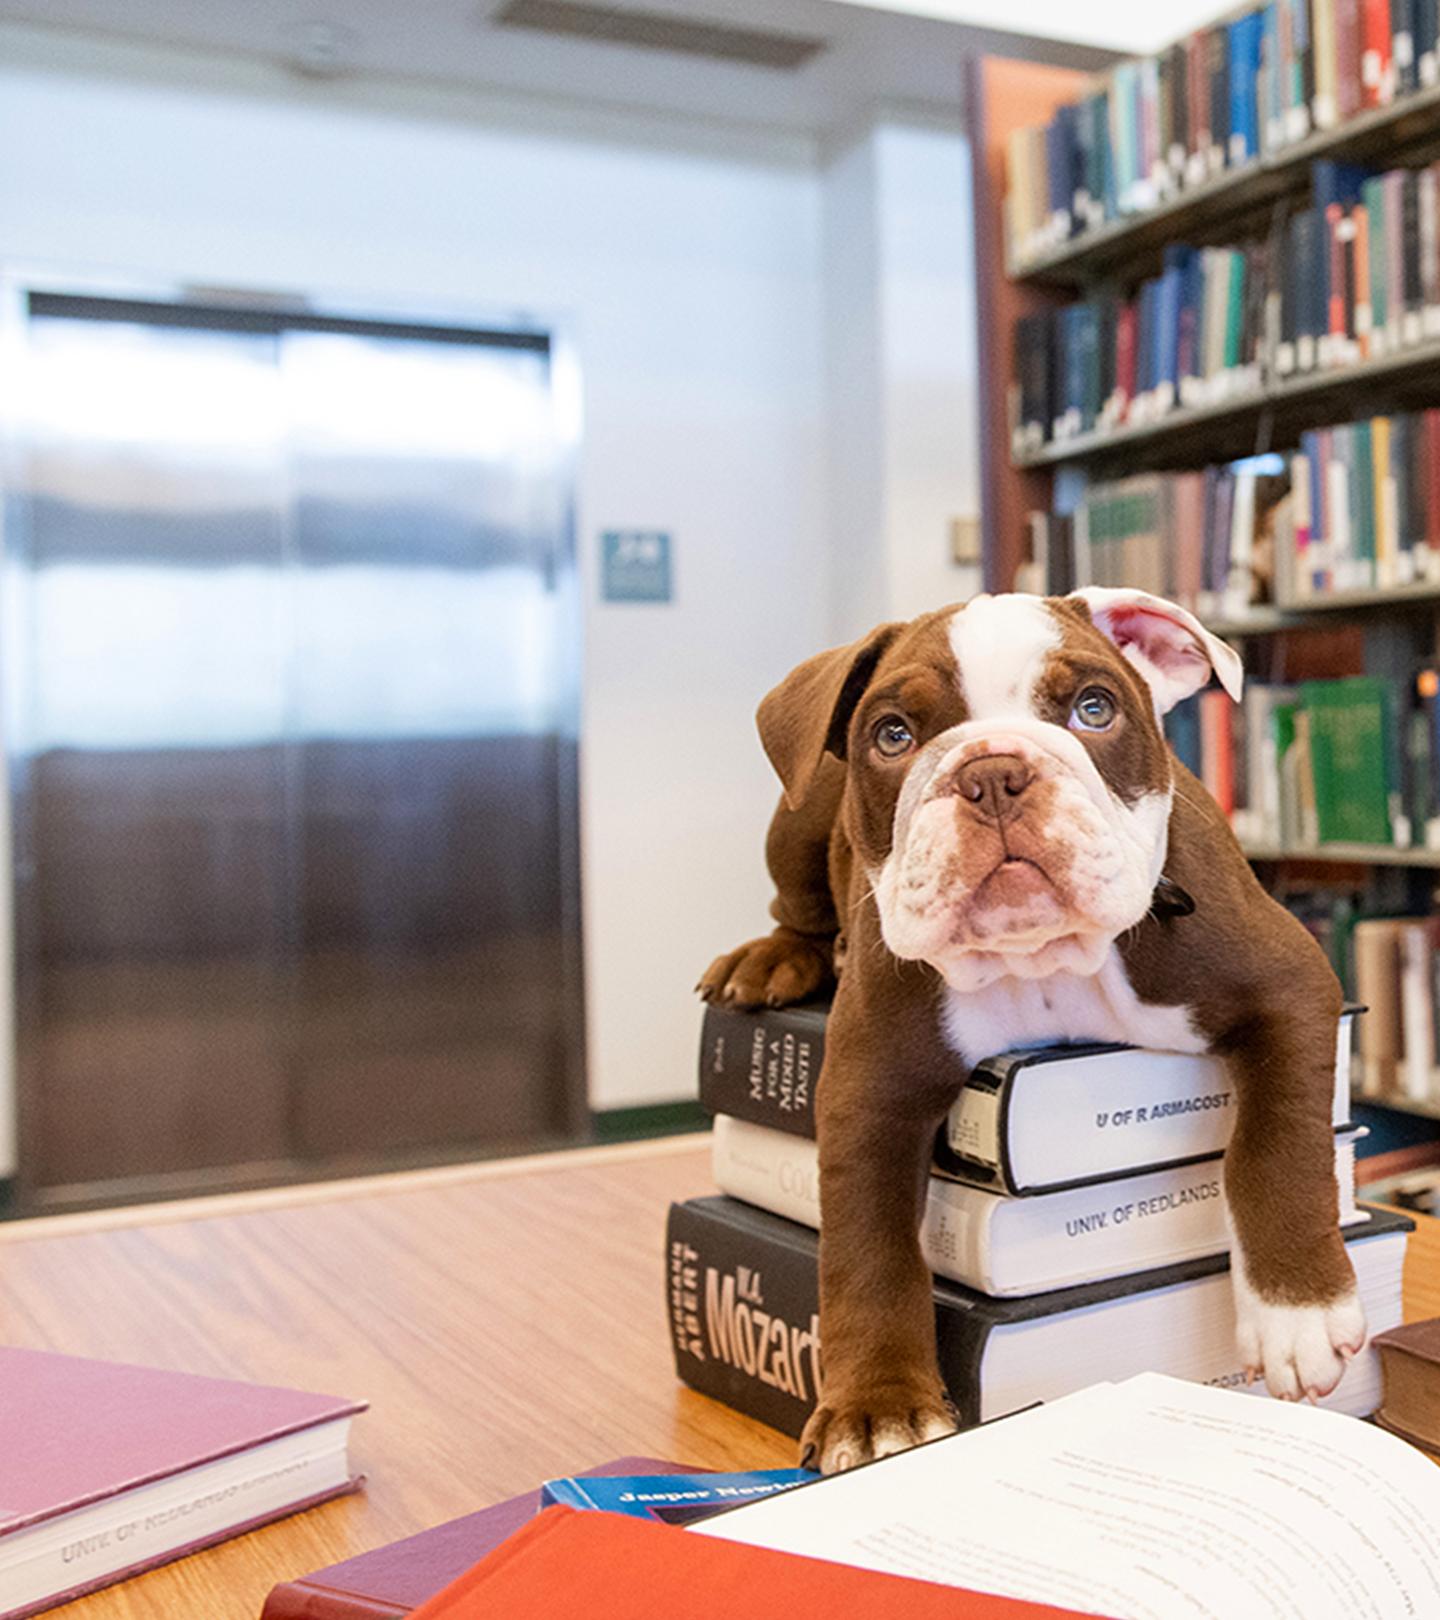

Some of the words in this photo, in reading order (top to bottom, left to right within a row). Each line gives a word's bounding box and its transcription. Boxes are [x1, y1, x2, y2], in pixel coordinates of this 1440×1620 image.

[769, 1041, 780, 1055] A
[1096, 1113, 1109, 1128] U
[1111, 1110, 1133, 1126] OF
[1136, 1107, 1149, 1123] R
[1150, 1092, 1232, 1120] ARMACOST
[1065, 1211, 1108, 1237] UNIV.
[1112, 1204, 1135, 1225] OF
[1137, 1181, 1221, 1218] REDLANDS
[706, 1267, 823, 1402] Mozart
